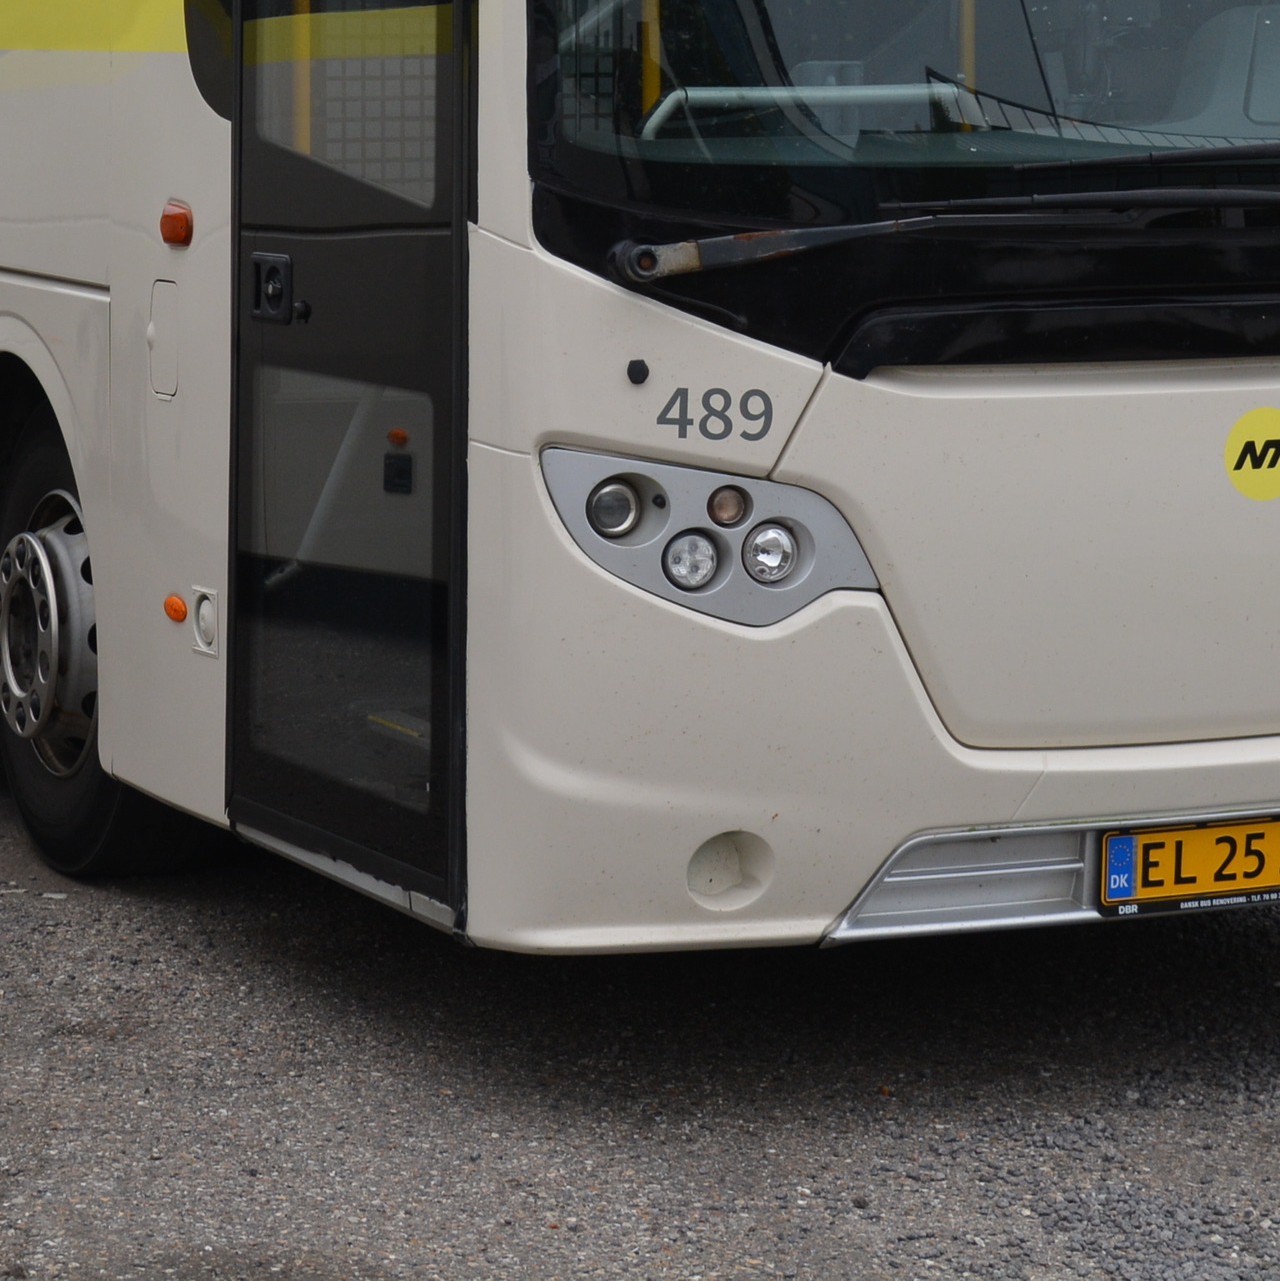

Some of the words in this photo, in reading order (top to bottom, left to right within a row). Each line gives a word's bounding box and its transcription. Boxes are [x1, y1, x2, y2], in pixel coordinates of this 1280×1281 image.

[656, 387, 773, 441] 489
[1141, 840, 1197, 888] EL
[1213, 832, 1266, 882] 25
[1110, 874, 1129, 889] DK
[1118, 904, 1138, 915] DBR
